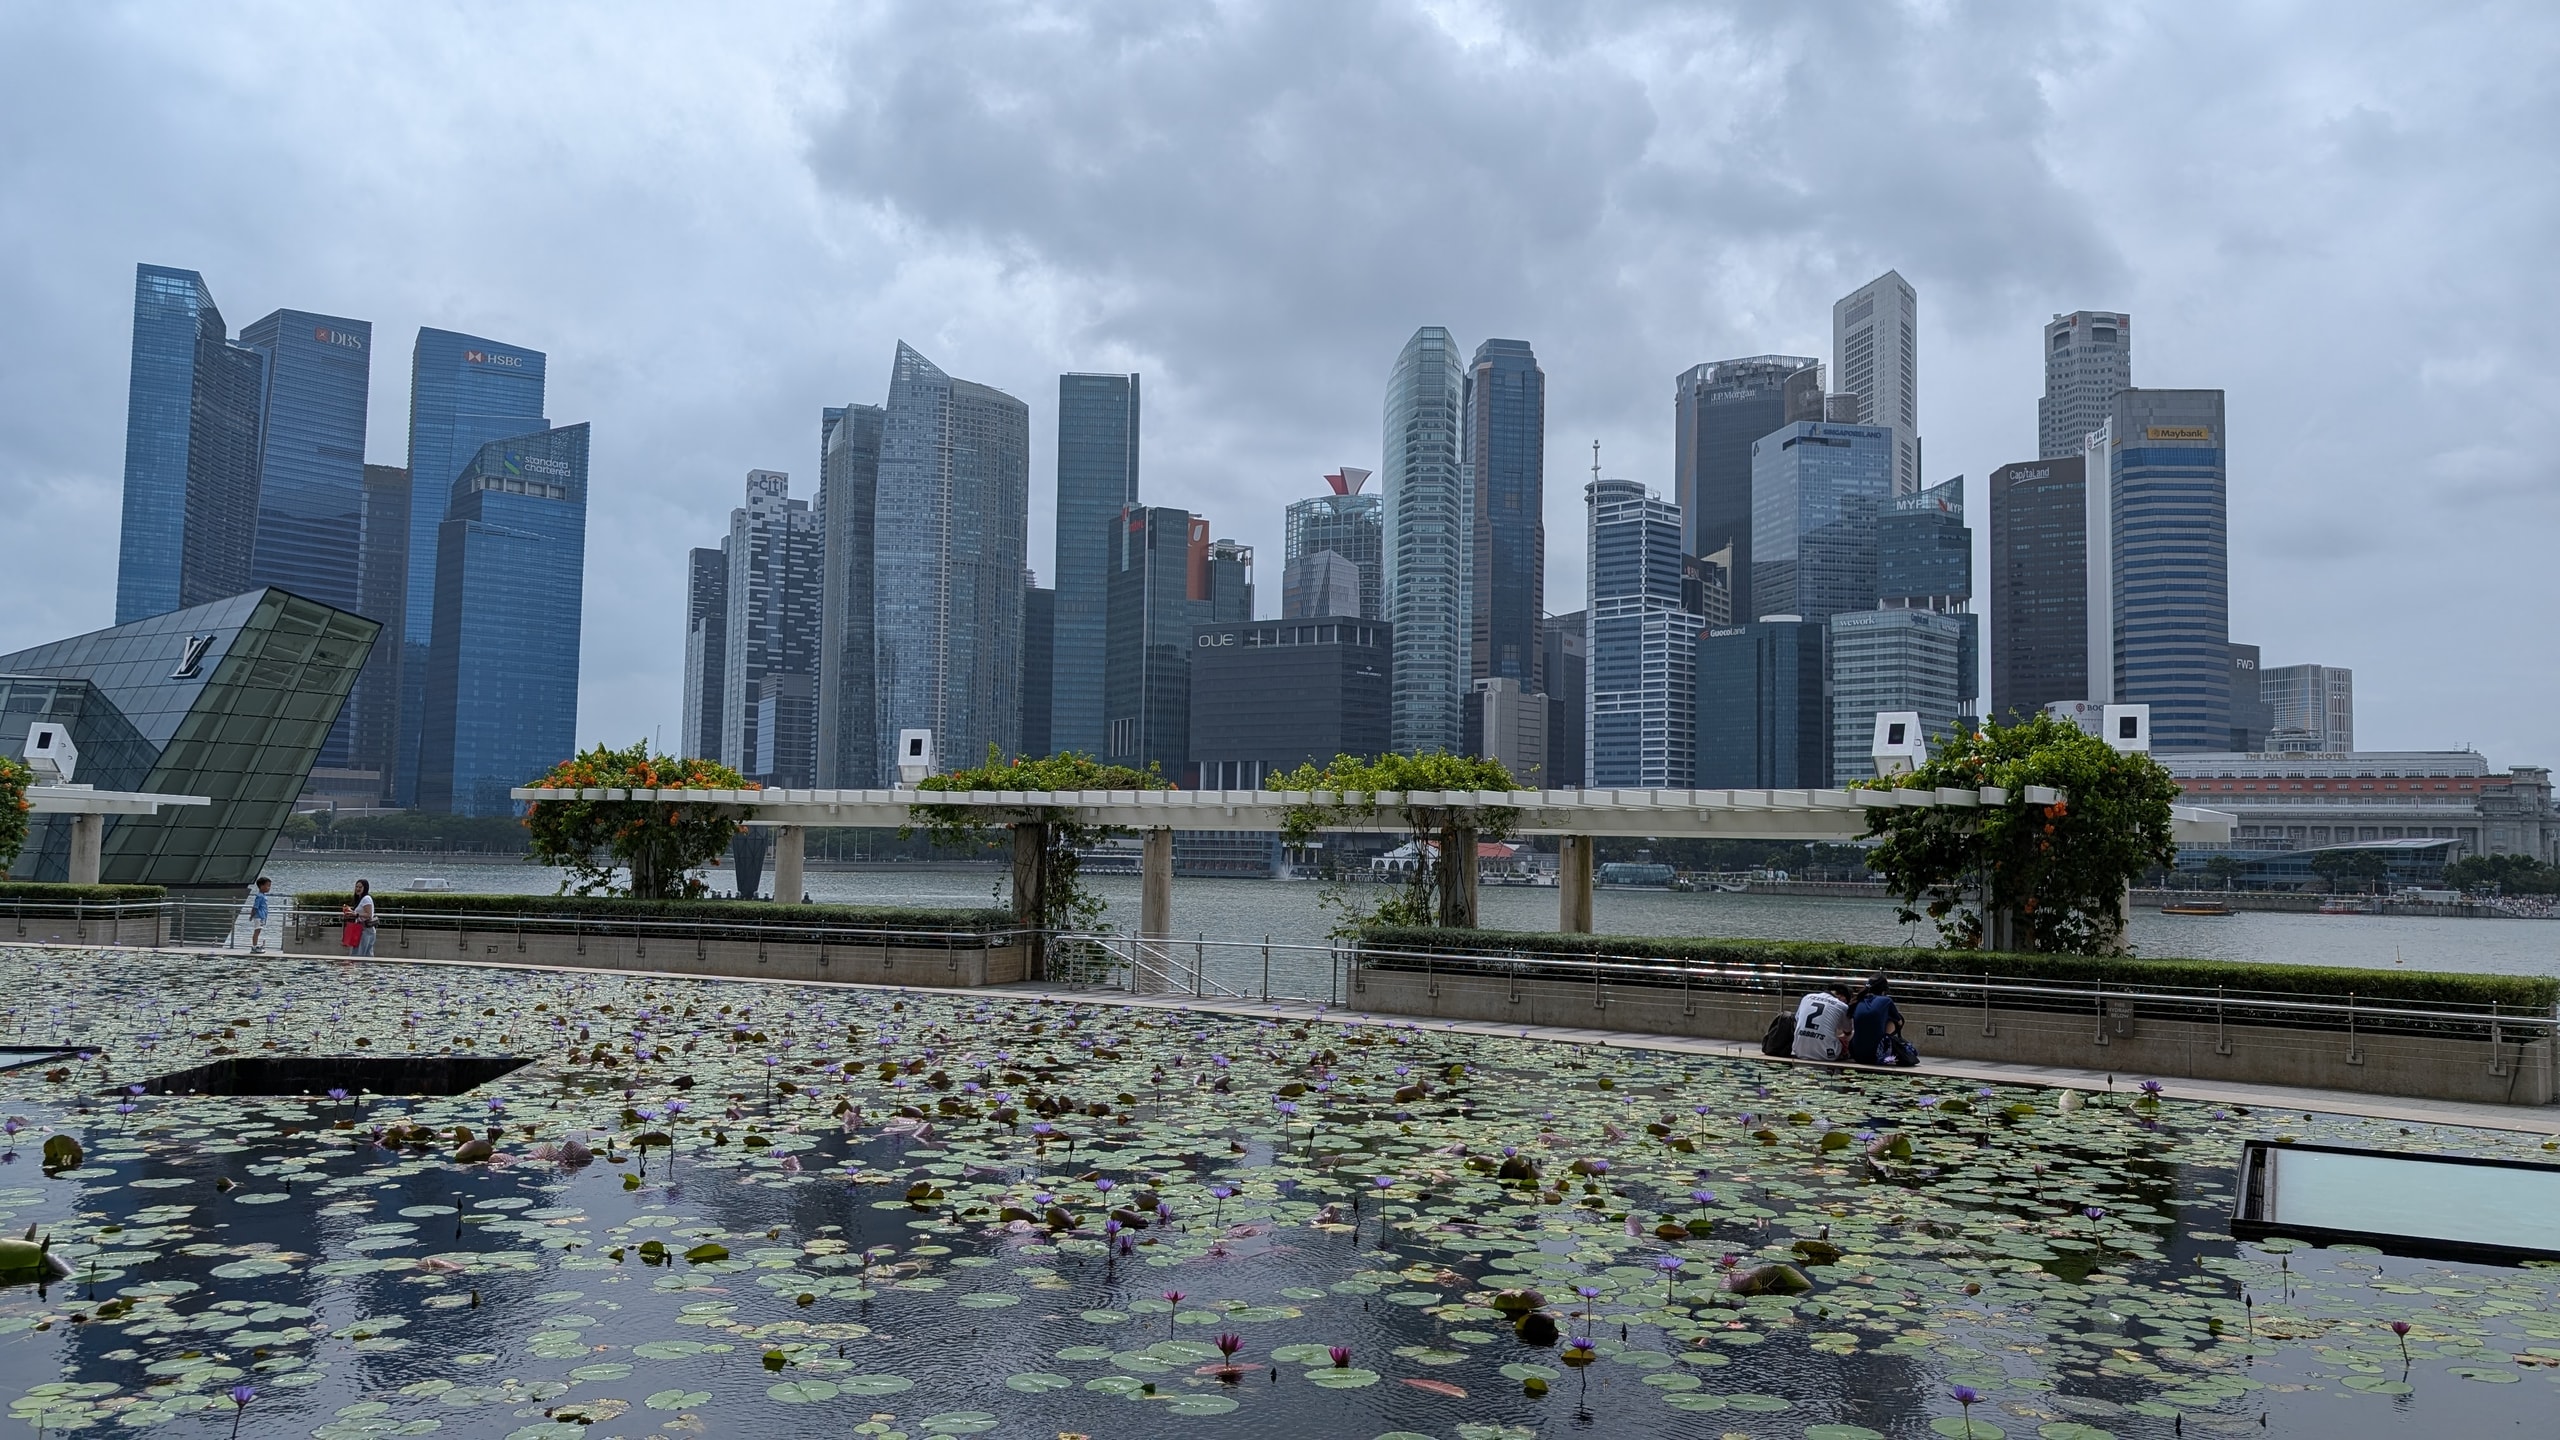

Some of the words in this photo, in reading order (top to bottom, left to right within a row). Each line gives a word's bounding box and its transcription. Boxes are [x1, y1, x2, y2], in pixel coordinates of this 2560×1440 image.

[331, 331, 361, 349] DBS
[487, 354, 522, 367] HSBC
[2160, 430, 2203, 438] Maybank
[525, 455, 569, 469] standard
[525, 463, 571, 477] chartered
[2010, 467, 2049, 482] CapitaLand
[759, 479, 783, 493] citi
[1897, 500, 1923, 511] MYP
[1947, 502, 1962, 514] MYP
[1840, 616, 1875, 626] wework
[1199, 634, 1234, 647] OUE
[2236, 658, 2254, 670] FWD
[1805, 1002, 1825, 1030] 2
